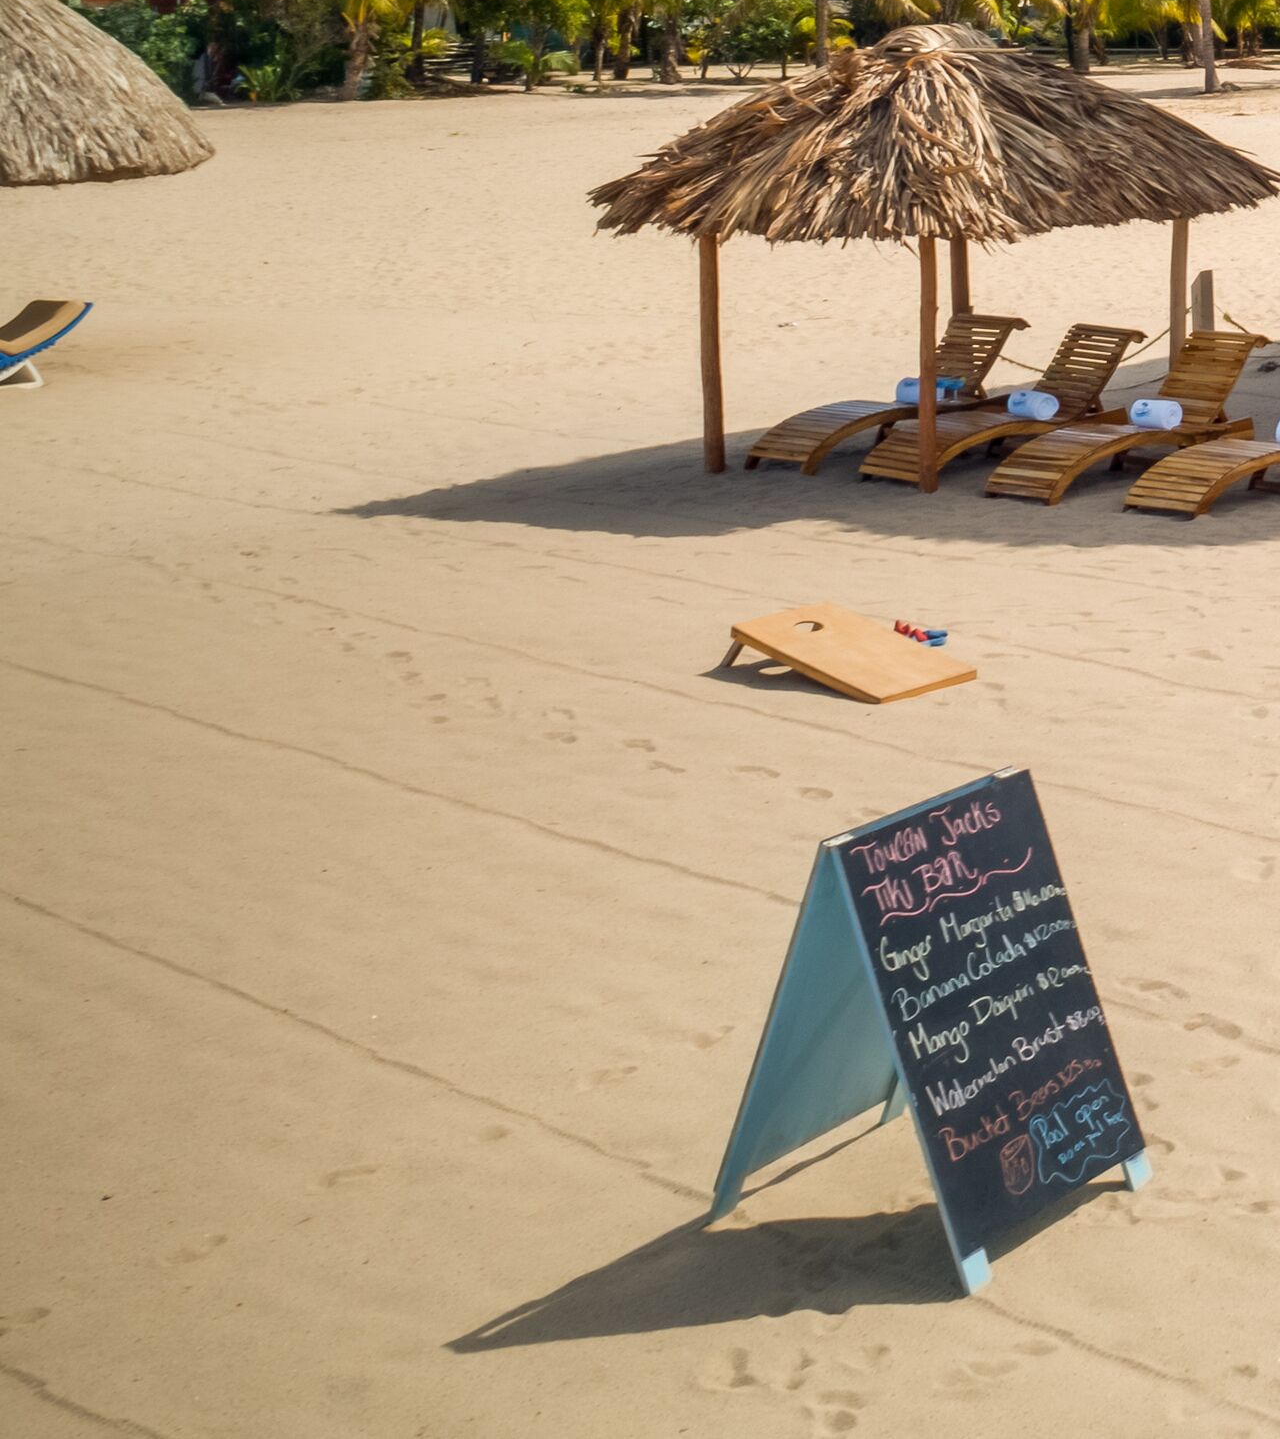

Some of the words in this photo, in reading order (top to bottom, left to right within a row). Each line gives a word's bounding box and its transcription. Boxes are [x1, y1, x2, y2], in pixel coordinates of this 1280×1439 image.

[879, 935, 932, 981] Ginger
[938, 896, 1014, 948] Margarita
[890, 972, 970, 1022] Banana
[907, 1021, 969, 1063] Mango
[938, 1105, 1010, 1161] Bucket
